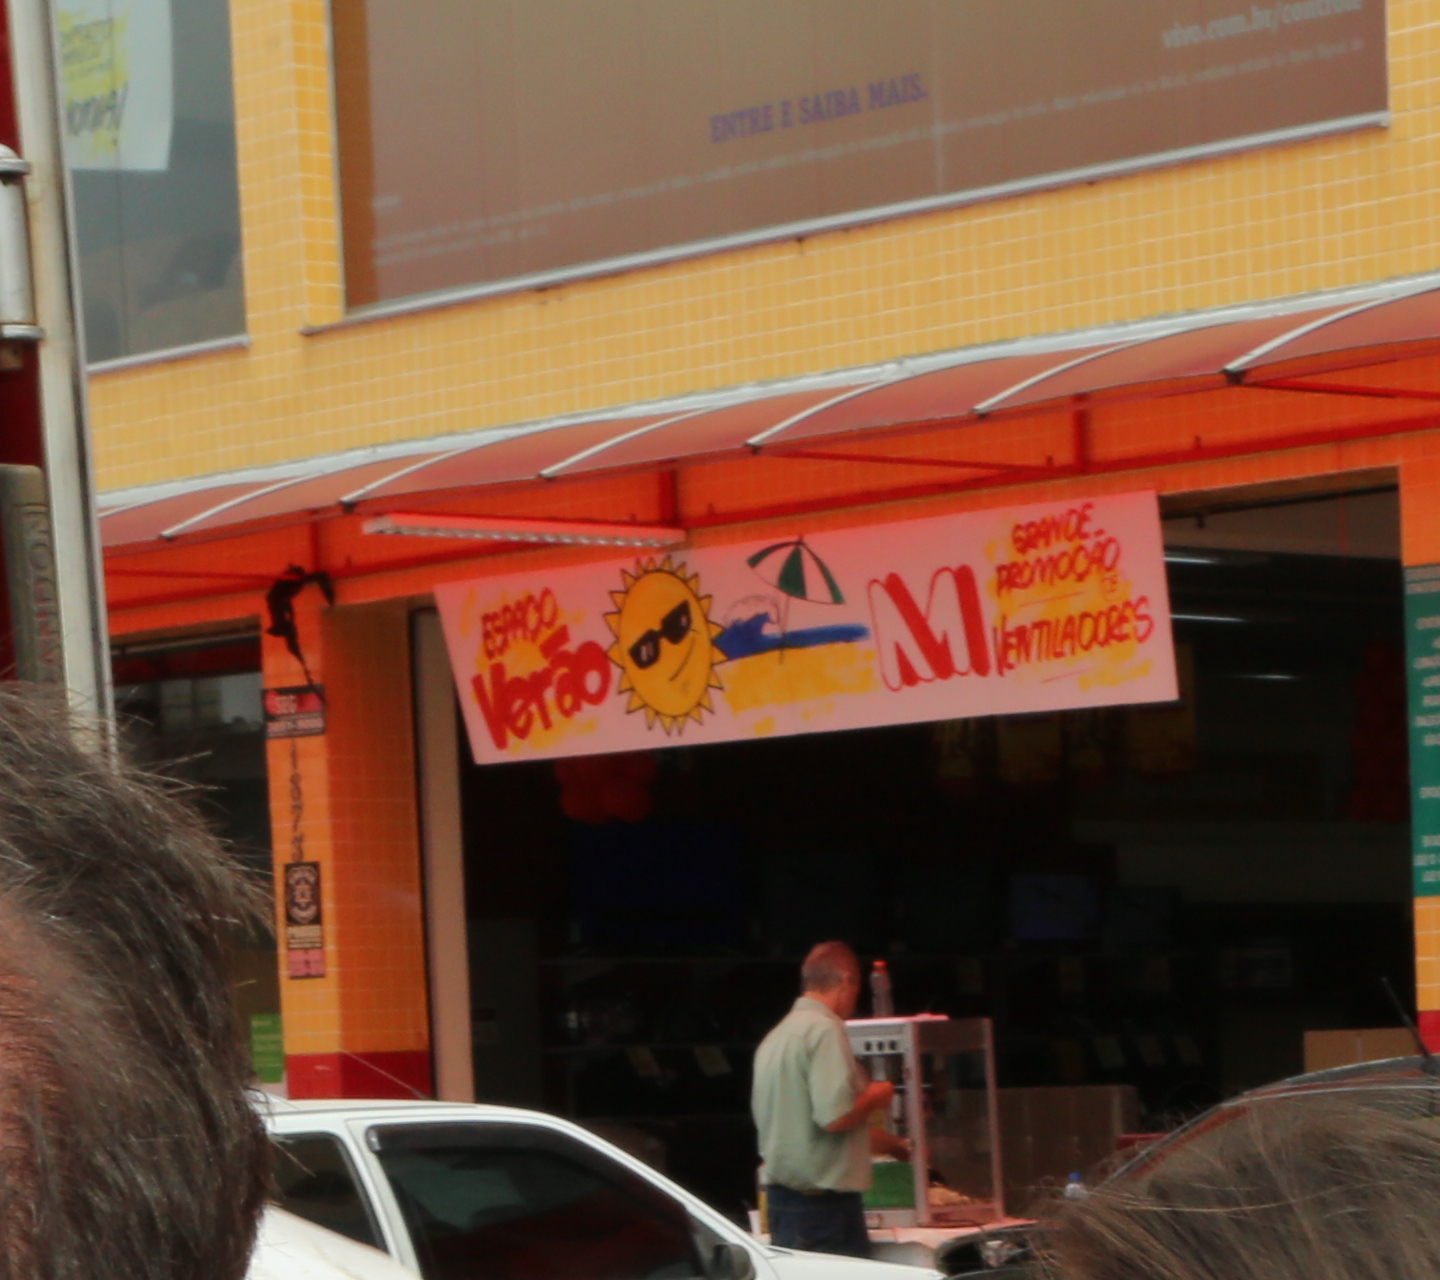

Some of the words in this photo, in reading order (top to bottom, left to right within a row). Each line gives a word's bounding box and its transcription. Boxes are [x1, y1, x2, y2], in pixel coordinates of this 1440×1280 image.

[710, 104, 774, 143] ENTRE
[781, 100, 793, 128] E
[799, 87, 862, 124] SAIBA
[868, 72, 929, 110] MAIS.
[995, 527, 1121, 600] PROMOÇÃO
[1012, 502, 1094, 555] GRANDE
[481, 586, 559, 661] ESPAÇO
[867, 564, 991, 692] M
[993, 594, 1156, 679] VENTILADORES
[471, 623, 612, 751] Verão
